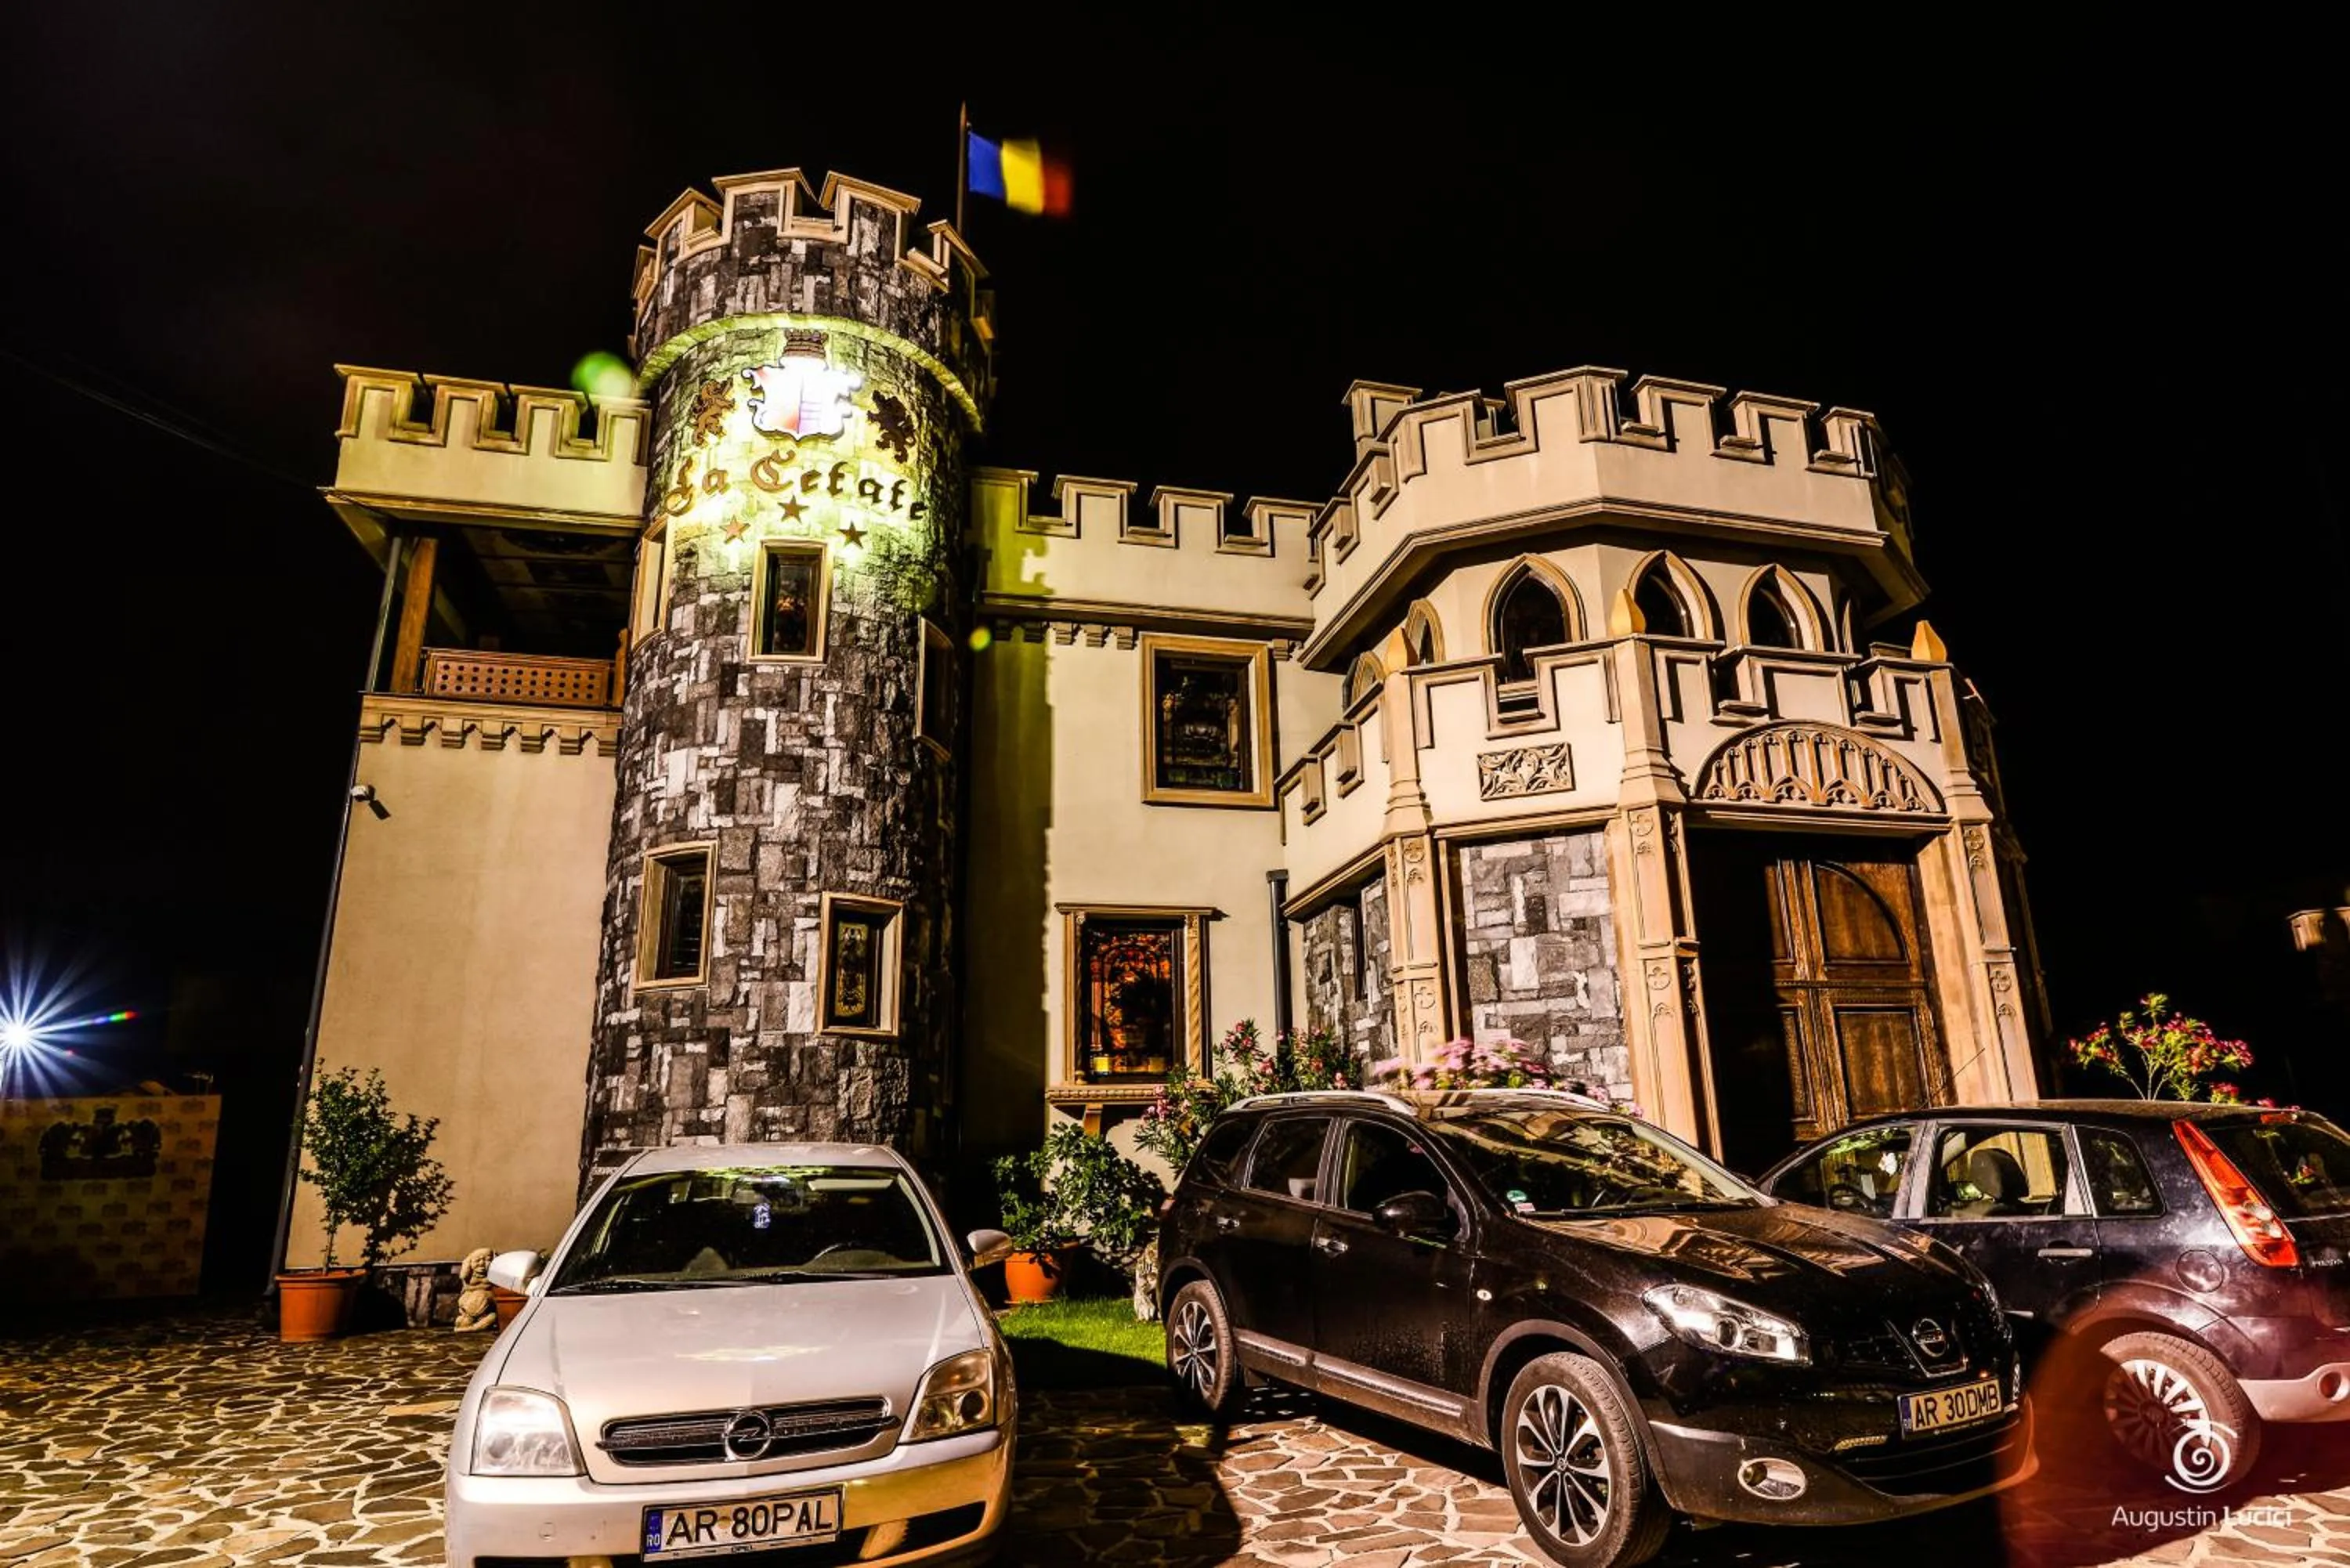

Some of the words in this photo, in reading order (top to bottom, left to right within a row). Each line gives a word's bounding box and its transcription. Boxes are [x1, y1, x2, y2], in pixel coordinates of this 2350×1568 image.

[663, 457, 728, 517] La
[750, 449, 928, 522] Cetate
[1915, 1396, 1939, 1428] AR
[1944, 1384, 1998, 1421] 30DMB
[646, 1532, 661, 1548] RO
[667, 1510, 718, 1545] AR
[730, 1500, 833, 1539] 80PAL
